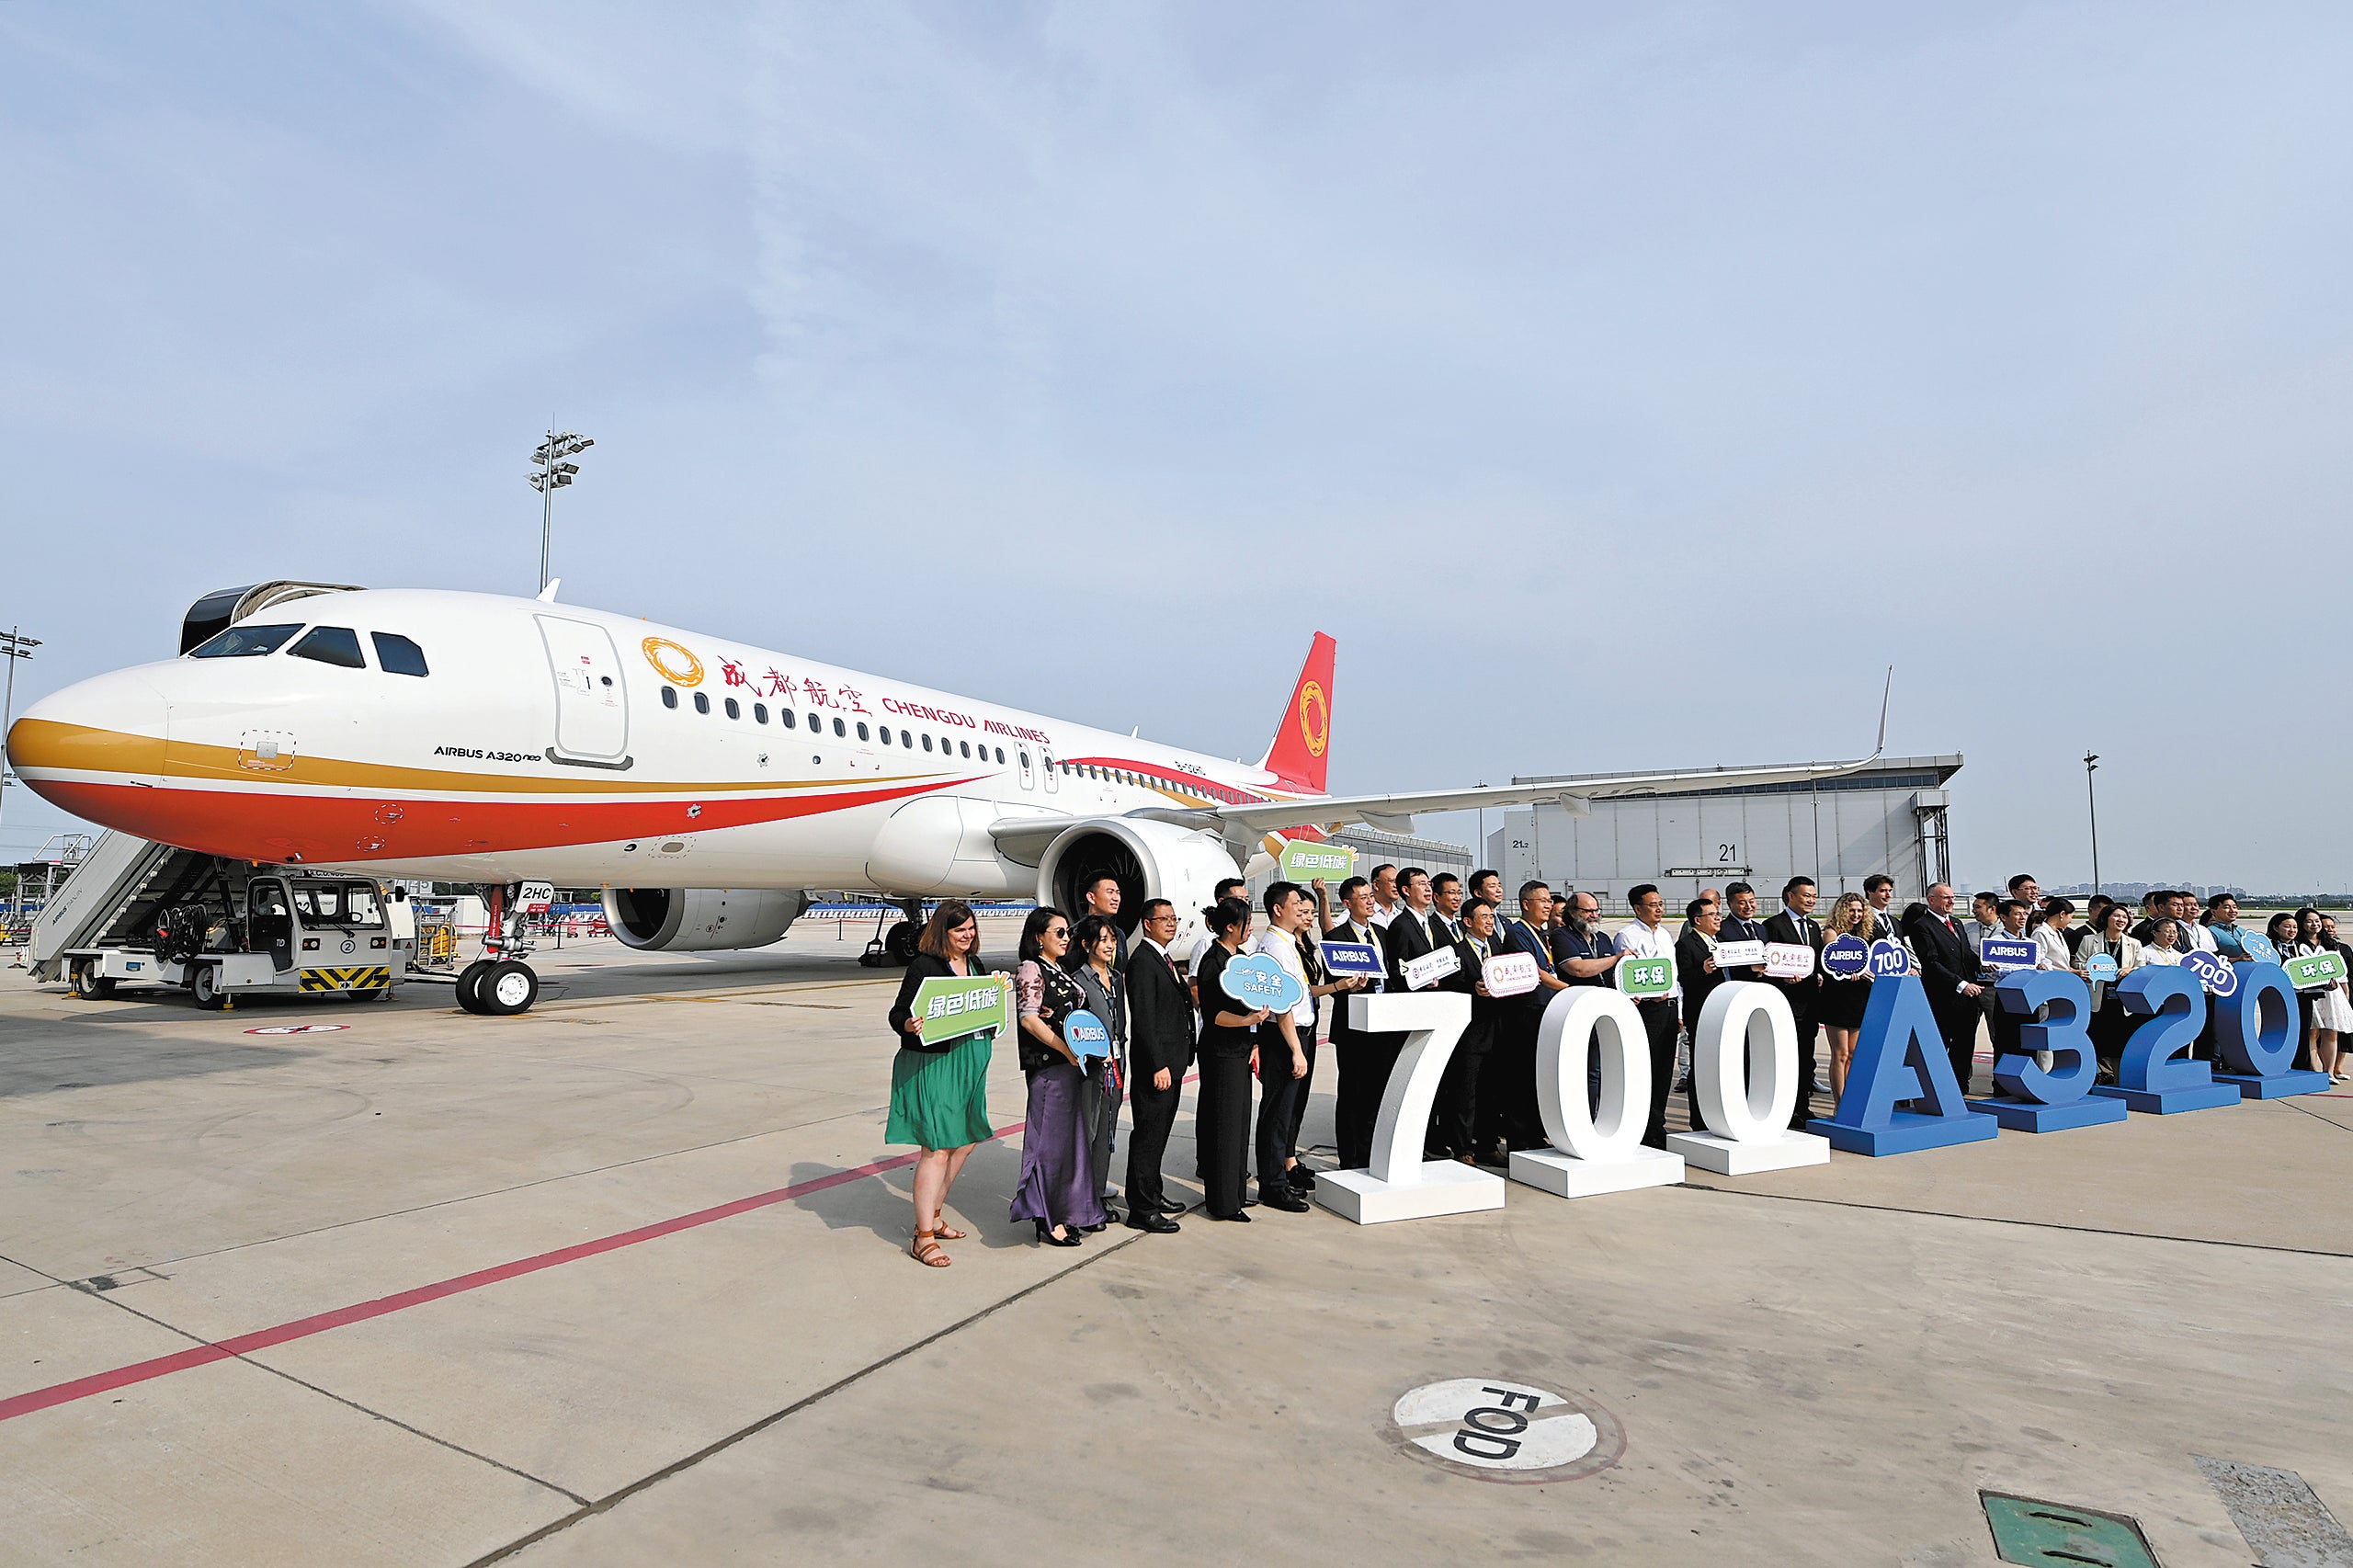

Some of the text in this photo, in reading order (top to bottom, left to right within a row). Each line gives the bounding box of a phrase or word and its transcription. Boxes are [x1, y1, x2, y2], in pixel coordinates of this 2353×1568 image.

[717, 655, 872, 717] 成都航空
[882, 698, 1051, 744] CHENGDU AIRLINES
[434, 746, 483, 759] AIRBUS
[1290, 852, 1347, 869] 绿色低碳
[1719, 844, 1736, 862] 21
[522, 887, 551, 900] 2HC
[1332, 949, 1370, 963] AIRBUS
[1829, 950, 1863, 960] AIRBUS
[1989, 946, 2028, 957] AIRBUS
[1875, 949, 1903, 973] 700
[2300, 960, 2336, 977] 环保
[1256, 971, 1282, 988] 安全
[1633, 966, 1665, 985] 环保
[2189, 957, 2229, 985] 700
[1244, 982, 1283, 997] SAFETY
[926, 985, 999, 1020] 绿色低碳
[1080, 1027, 1105, 1041] AIRBUS
[1453, 1387, 1540, 1460] FOD
